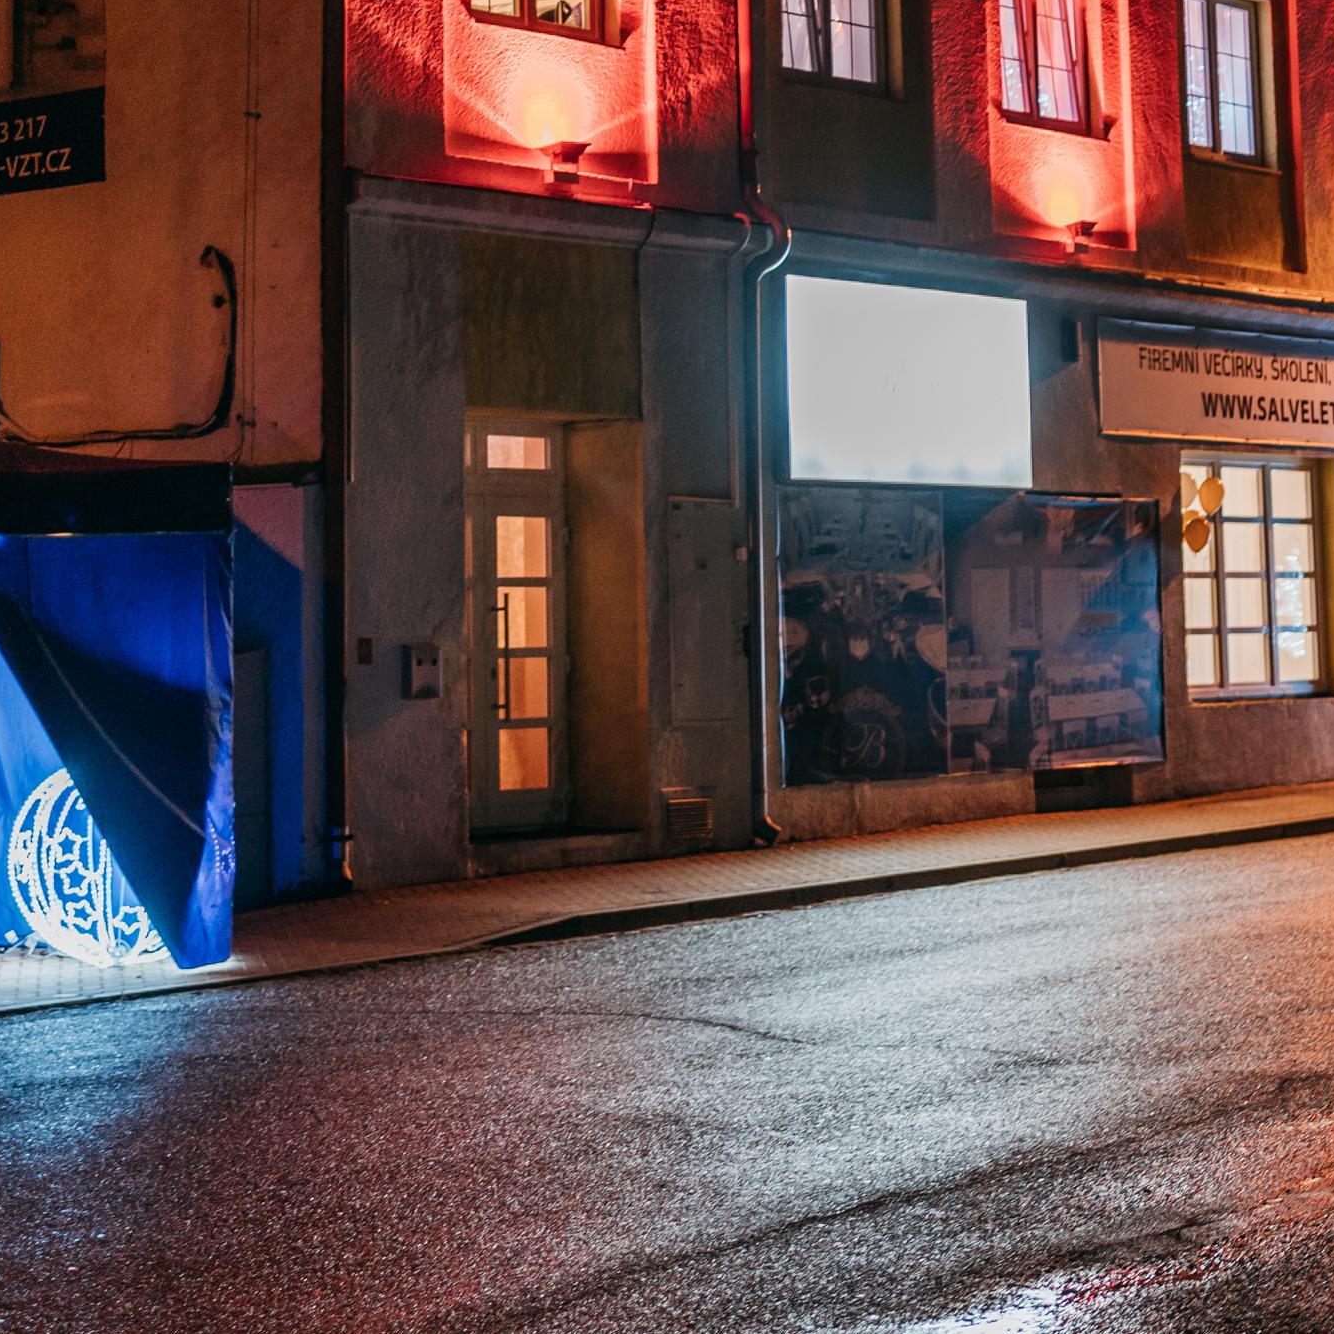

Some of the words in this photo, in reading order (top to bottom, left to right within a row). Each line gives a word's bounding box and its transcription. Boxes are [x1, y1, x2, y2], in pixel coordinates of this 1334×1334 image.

[13, 115, 47, 142] 217
[1139, 346, 1200, 374] FIREMNÍ
[1203, 348, 1267, 381] VEČÍRKY,
[1271, 353, 1331, 385] ŠKOLENÍ,
